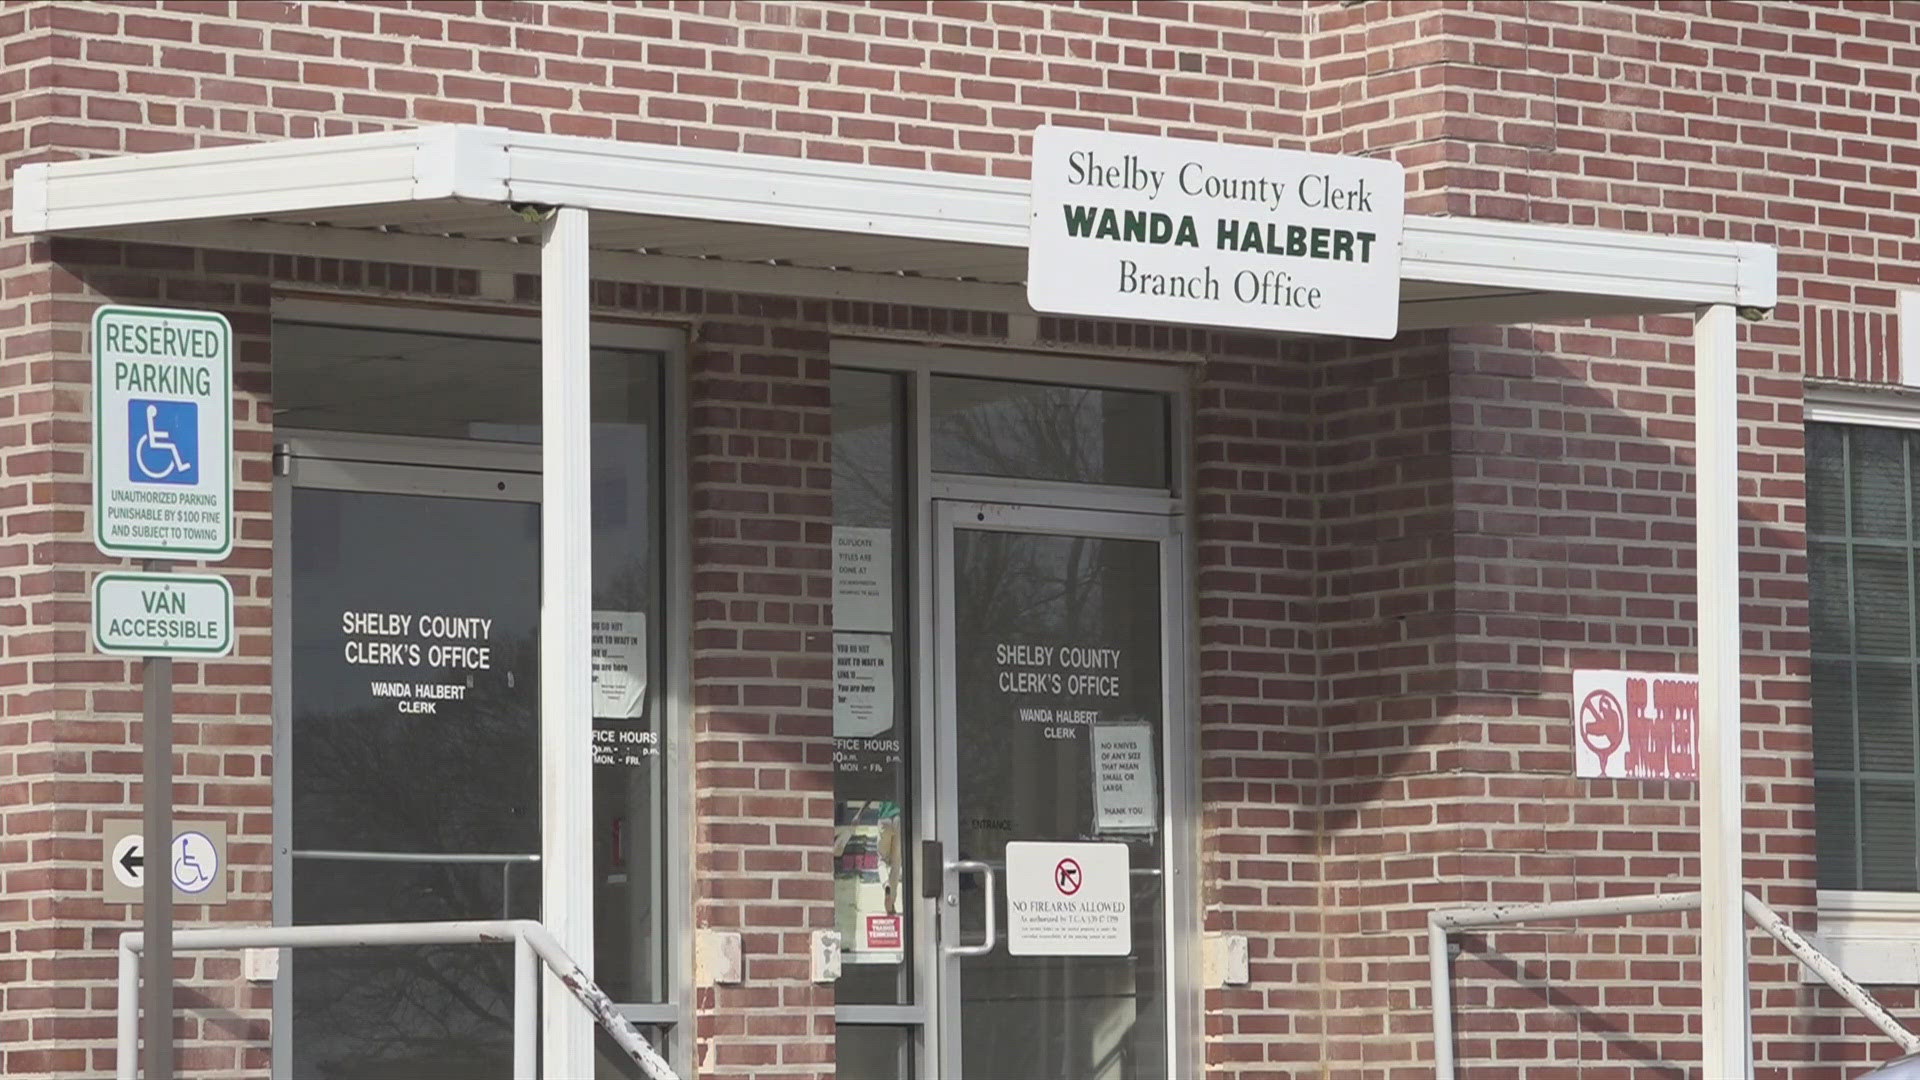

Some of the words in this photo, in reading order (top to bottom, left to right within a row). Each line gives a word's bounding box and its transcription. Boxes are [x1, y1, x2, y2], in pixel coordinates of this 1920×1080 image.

[1067, 150, 1166, 200] Shelby
[1178, 161, 1286, 212] County
[1298, 173, 1373, 213] Clerk
[1063, 204, 1199, 248] WANDA
[1216, 218, 1376, 263] HALBERT
[1118, 260, 1219, 300] Branch
[1234, 269, 1322, 310] Office
[106, 323, 220, 359] RESERVED
[115, 362, 211, 397] PARKING
[111, 489, 178, 505] UNAUTHORIZED
[179, 492, 217, 507] PARKING
[107, 506, 163, 521] PUNISHABLE
[164, 509, 176, 521] BY
[177, 510, 200, 523] $100
[201, 511, 221, 524] FINE
[111, 525, 130, 537] AND
[132, 525, 169, 539] SUBJECT
[169, 527, 181, 539] TO
[183, 528, 218, 541] TOWING
[141, 590, 186, 615] VAN
[109, 617, 218, 640] ACCESSIBLE
[342, 611, 412, 636] SHELBY
[419, 615, 492, 640] COUNTY
[592, 635, 603, 645] AVE
[344, 641, 421, 667] CLERK'S
[428, 645, 490, 669] OFFICE
[996, 644, 1053, 666] SHELBY
[1060, 647, 1121, 669] COUNTY
[371, 682, 412, 698] WANDA
[415, 684, 466, 700] HALBERT
[999, 671, 1062, 694] CLERK'S
[1068, 675, 1119, 697] OFFICE
[398, 701, 436, 714] CLERK
[1020, 708, 1053, 723] WANDA
[1056, 710, 1098, 724] HALBERT
[619, 731, 658, 744] HOURS
[1044, 727, 1076, 739] CLERK
[864, 740, 900, 752] HOURS
[1113, 742, 1137, 750] KNIVES
[1101, 752, 1110, 760] OF
[1103, 773, 1122, 781] SMALL
[1103, 784, 1122, 792] LARGE
[1104, 807, 1126, 815] THANK
[1013, 901, 1027, 912] NO
[1030, 901, 1077, 912] FIREARMS
[1080, 901, 1125, 913] ALLOWED
